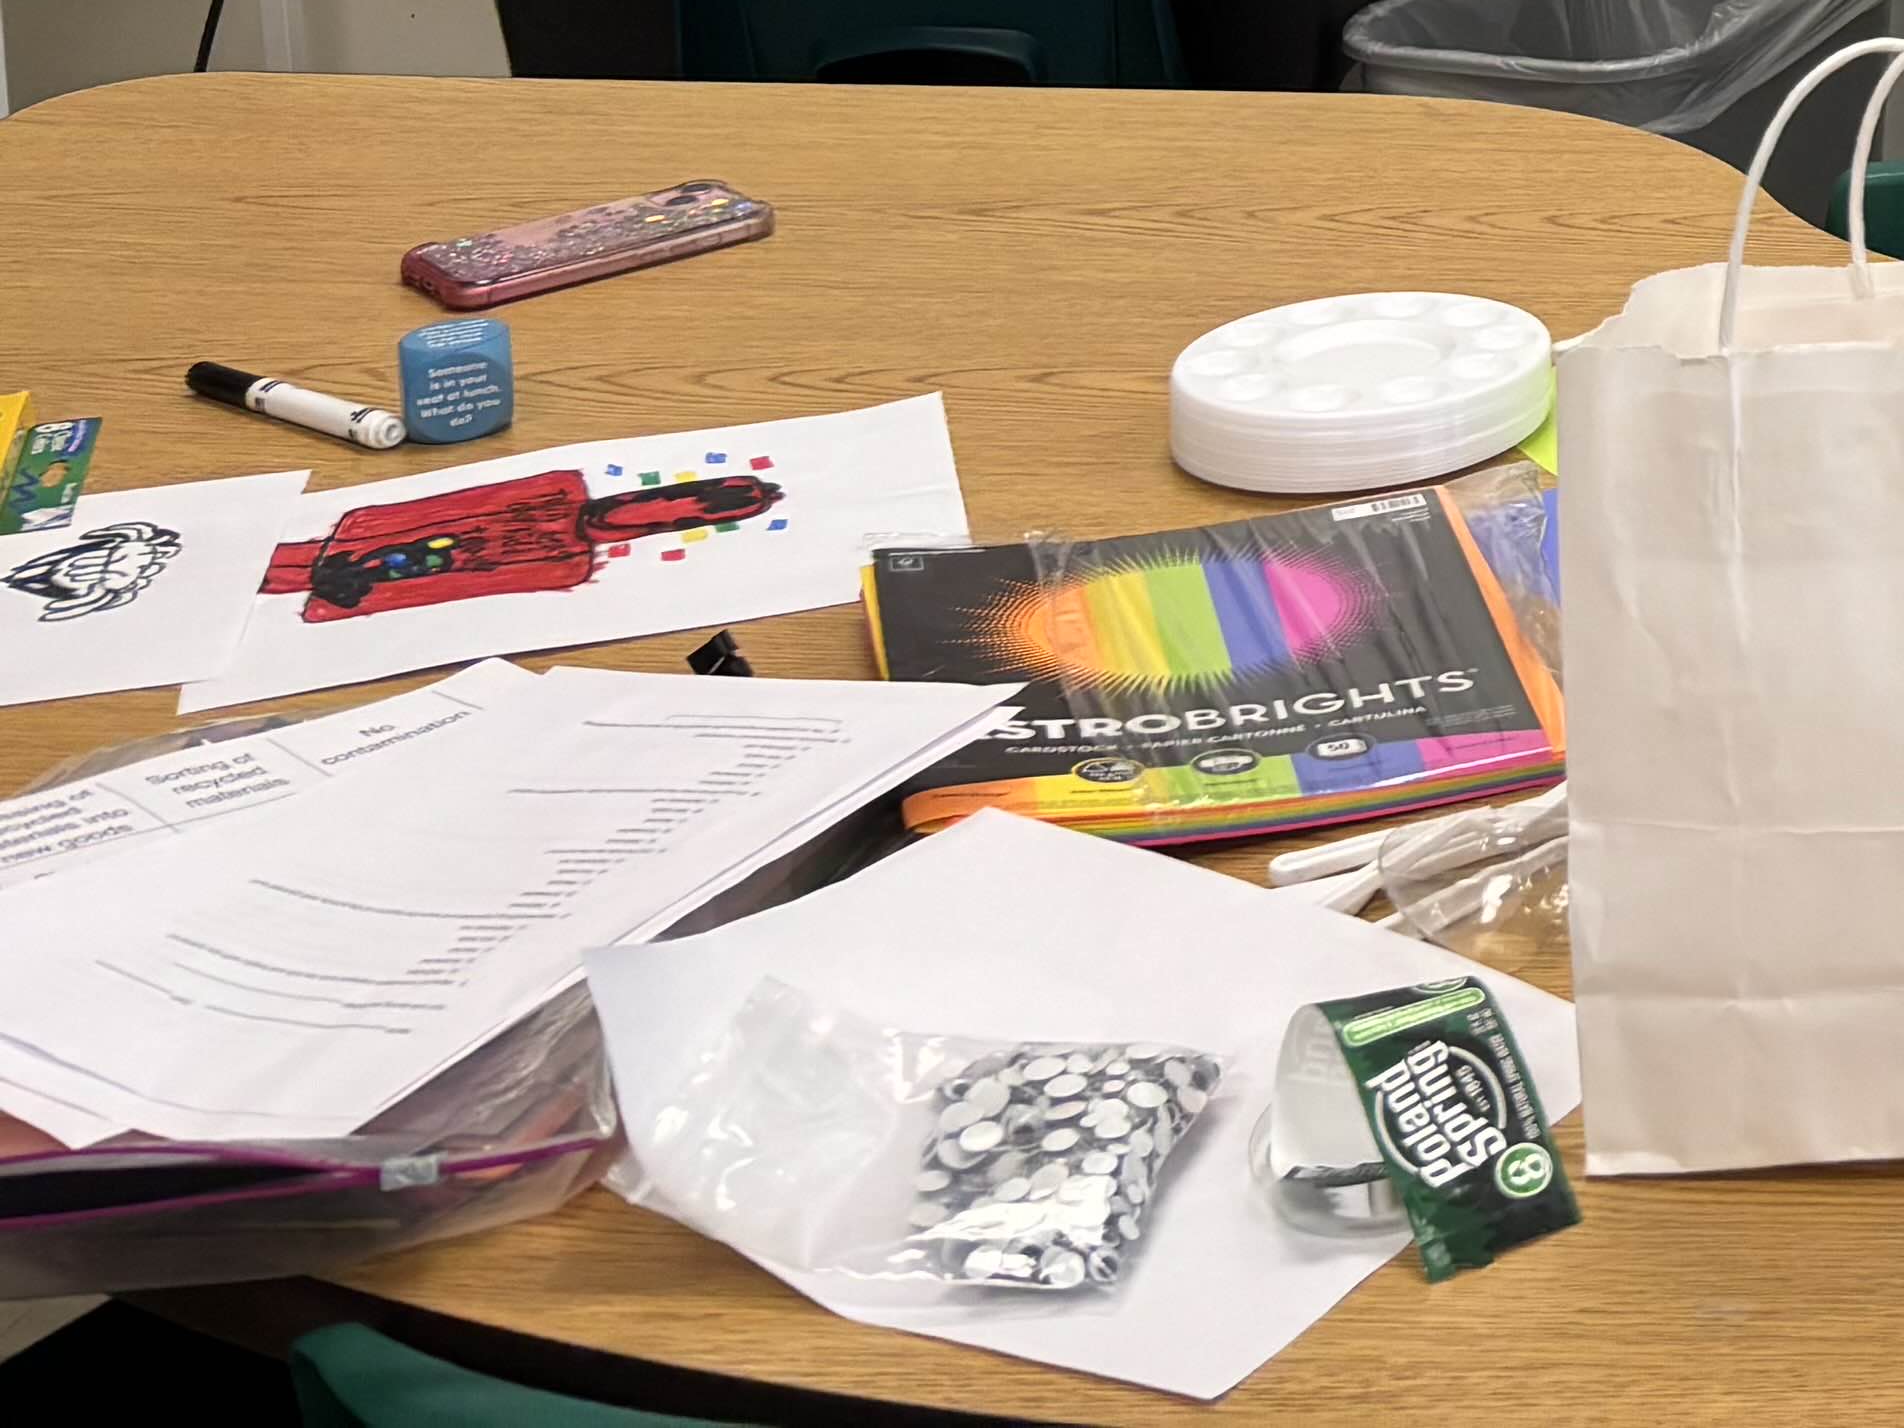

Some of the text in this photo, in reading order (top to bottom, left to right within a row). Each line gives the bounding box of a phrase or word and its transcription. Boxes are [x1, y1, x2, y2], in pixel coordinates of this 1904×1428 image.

[427, 361, 489, 379] Someone
[429, 373, 488, 391] is in your
[416, 393, 444, 406] seat
[446, 391, 460, 401] at
[421, 399, 501, 419] What do you
[449, 413, 473, 427] do?
[321, 709, 472, 767] contamination
[358, 723, 396, 739] No
[144, 752, 257, 786] Sorting of
[171, 765, 269, 796] recycled
[185, 777, 292, 810] materials
[57, 822, 136, 851] goods
[1405, 1039, 1508, 1170] Spring
[1365, 1058, 1470, 1189] Poland
